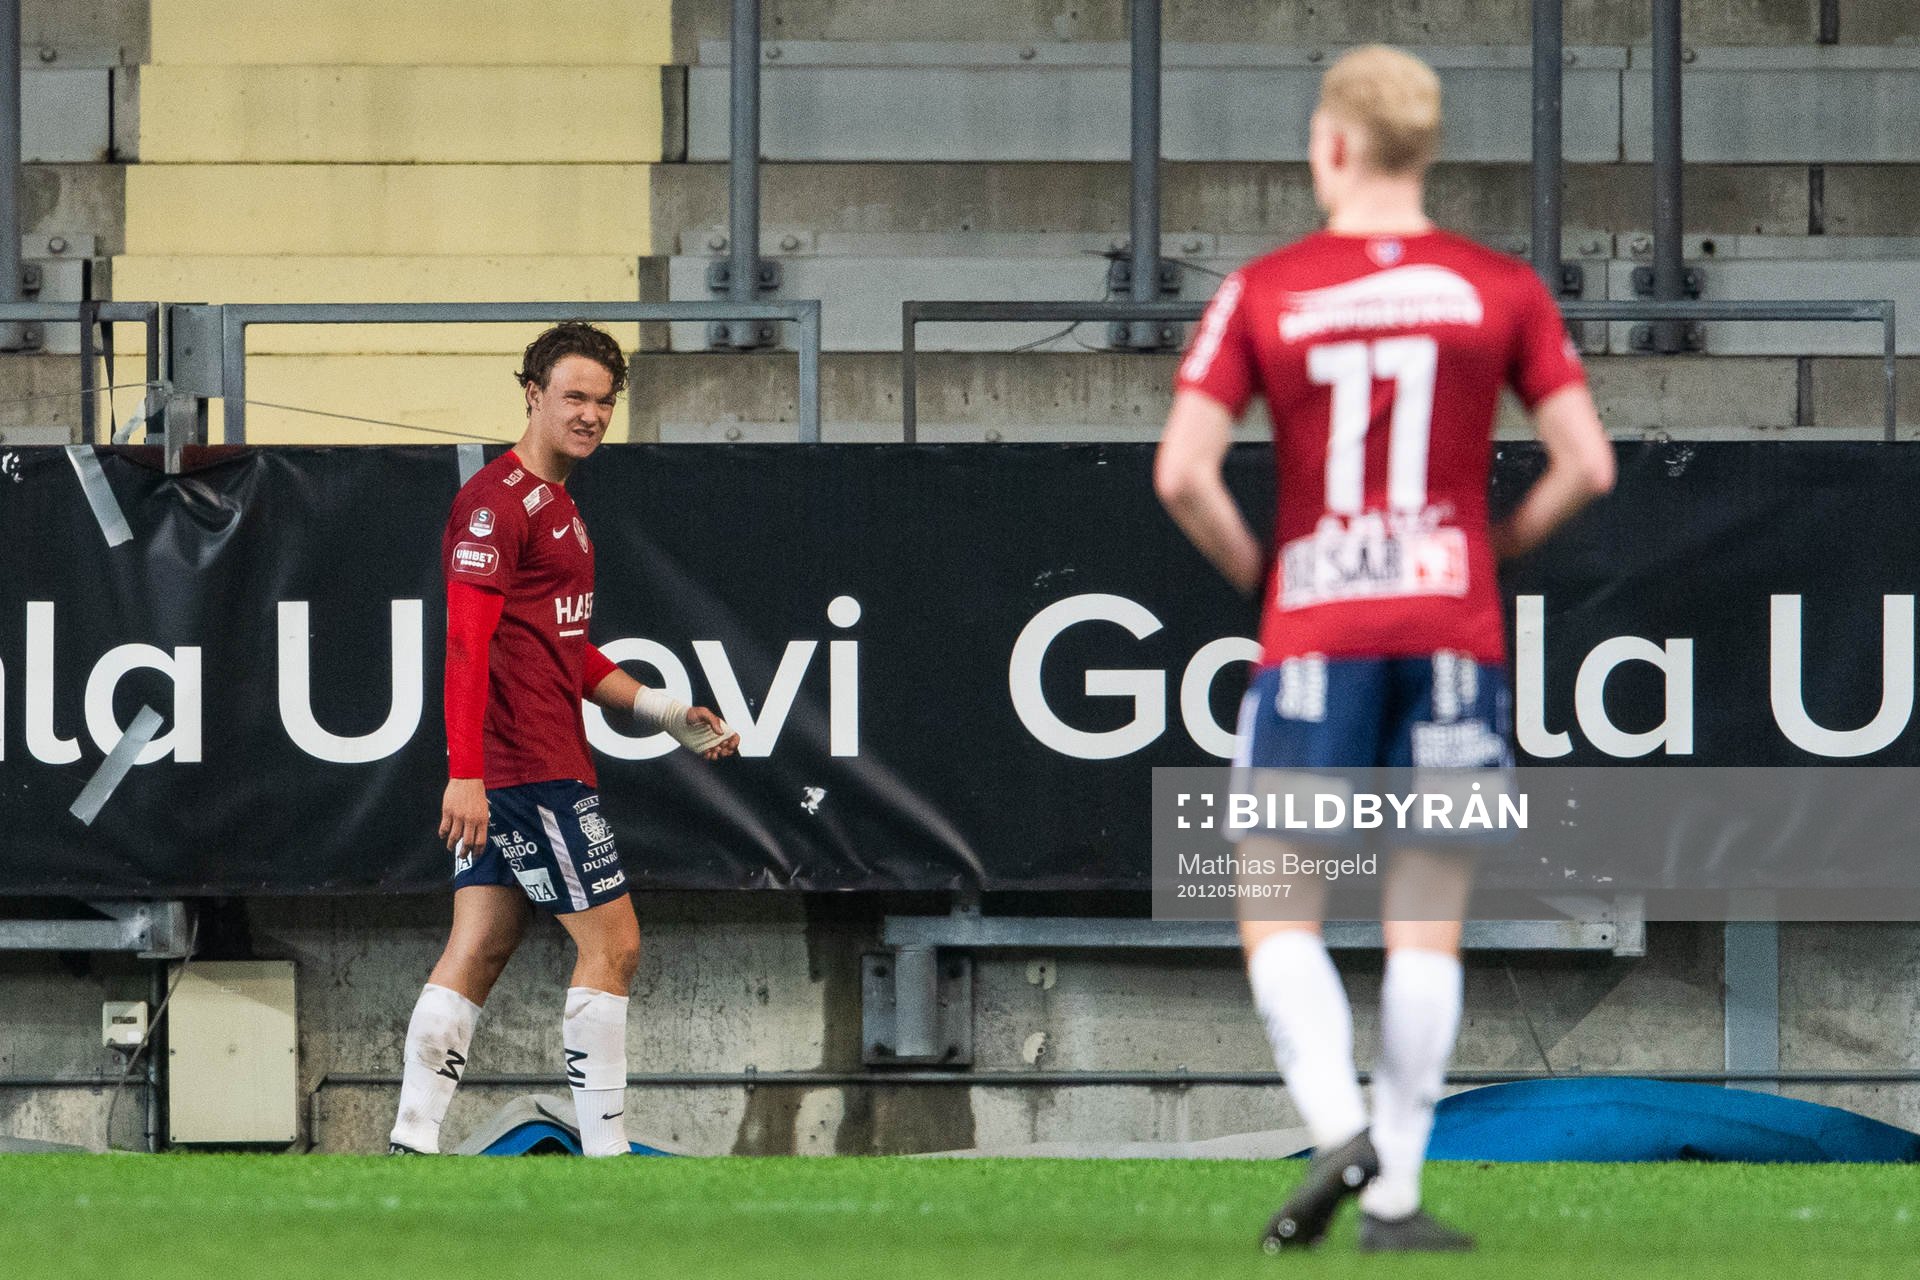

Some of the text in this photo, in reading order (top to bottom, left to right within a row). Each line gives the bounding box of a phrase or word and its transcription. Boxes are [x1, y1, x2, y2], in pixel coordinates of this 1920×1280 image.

[456, 549, 494, 564] UNIBET
[0, 601, 202, 764] la
[277, 597, 860, 763] Uevi
[1008, 592, 1694, 760] Gala
[512, 830, 525, 844] &
